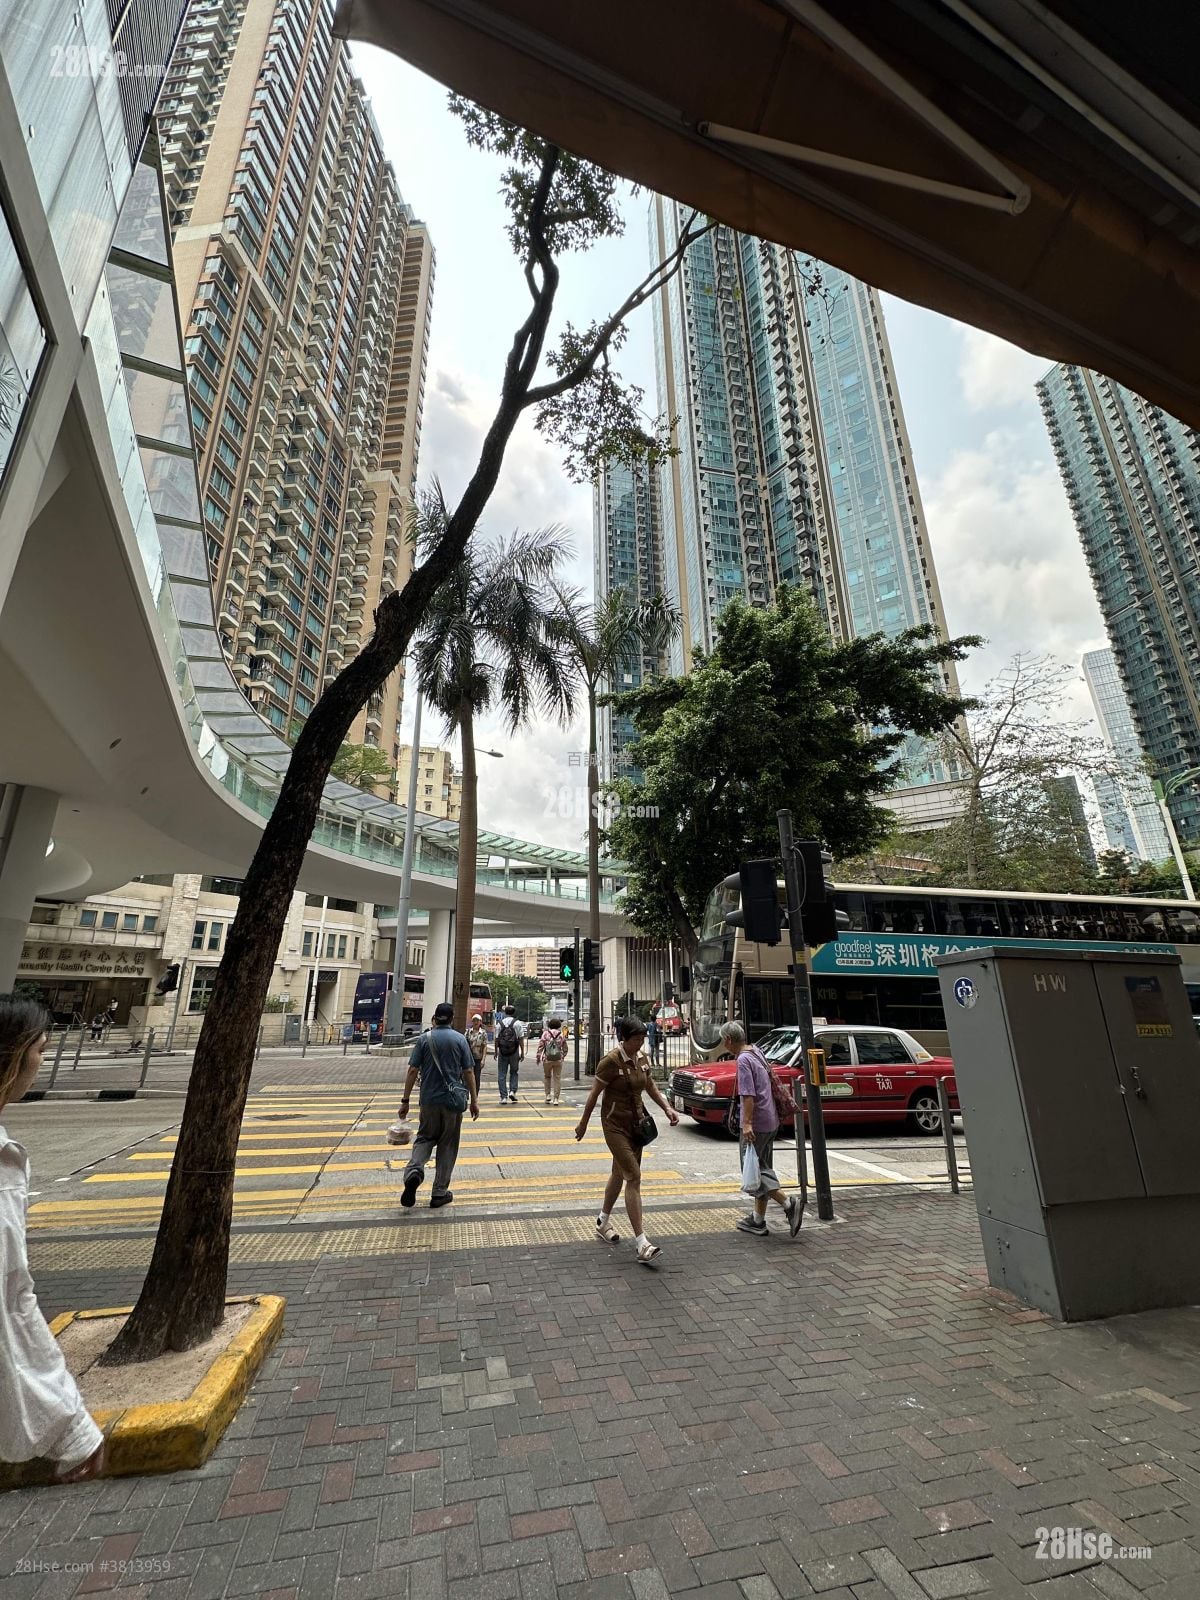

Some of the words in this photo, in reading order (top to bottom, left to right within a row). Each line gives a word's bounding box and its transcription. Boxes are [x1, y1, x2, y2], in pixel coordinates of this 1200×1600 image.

[834, 939, 873, 958] goodfeel
[875, 943, 981, 968] 深圳格
[1033, 974, 1067, 993] HW
[876, 1081, 893, 1090] TAXI
